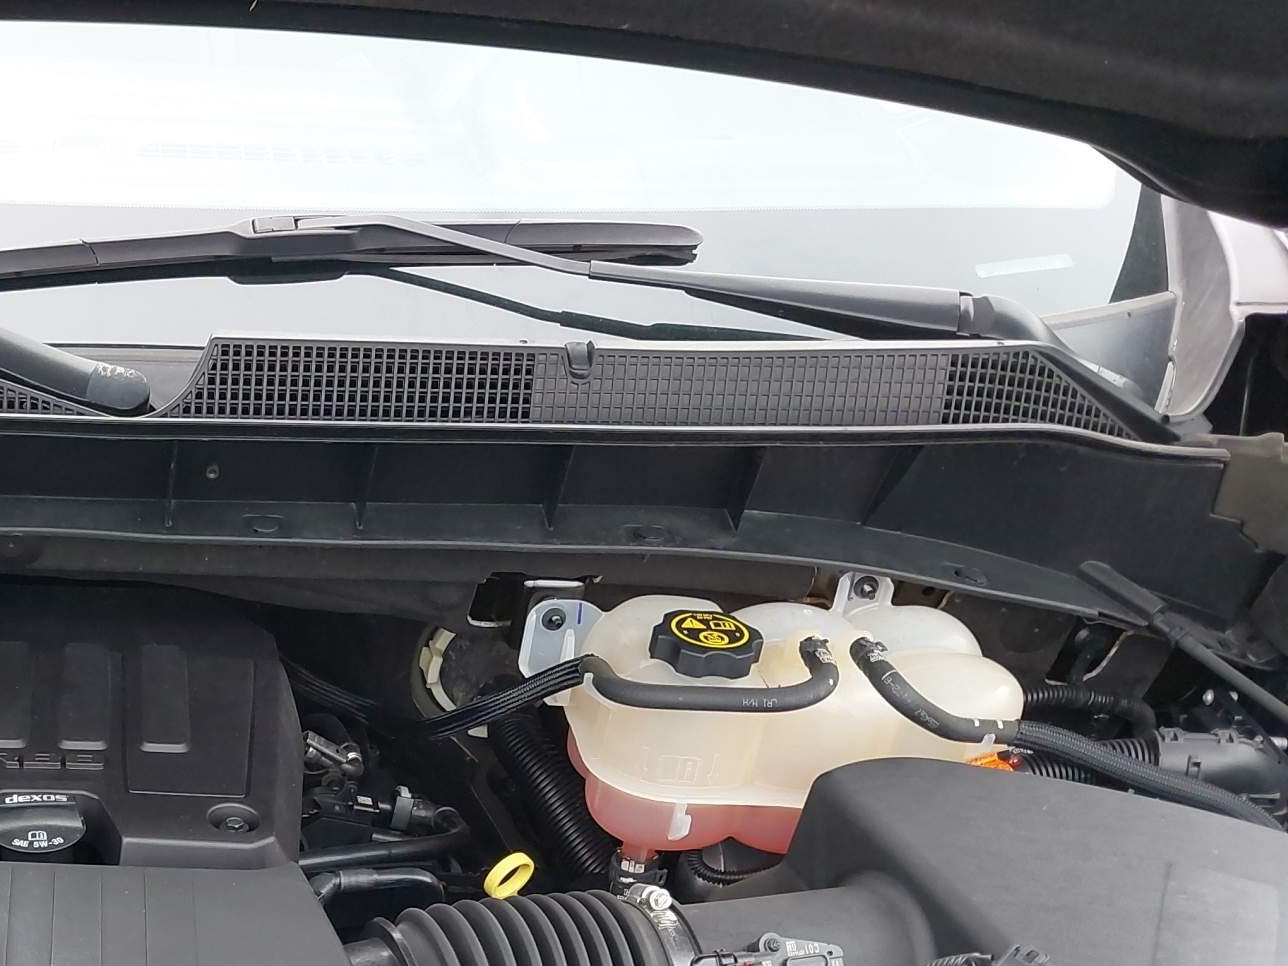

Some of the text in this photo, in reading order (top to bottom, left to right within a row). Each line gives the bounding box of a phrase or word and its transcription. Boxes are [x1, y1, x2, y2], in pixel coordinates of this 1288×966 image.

[4, 794, 68, 804] dexos
[11, 837, 65, 848] SAE 5W-30
